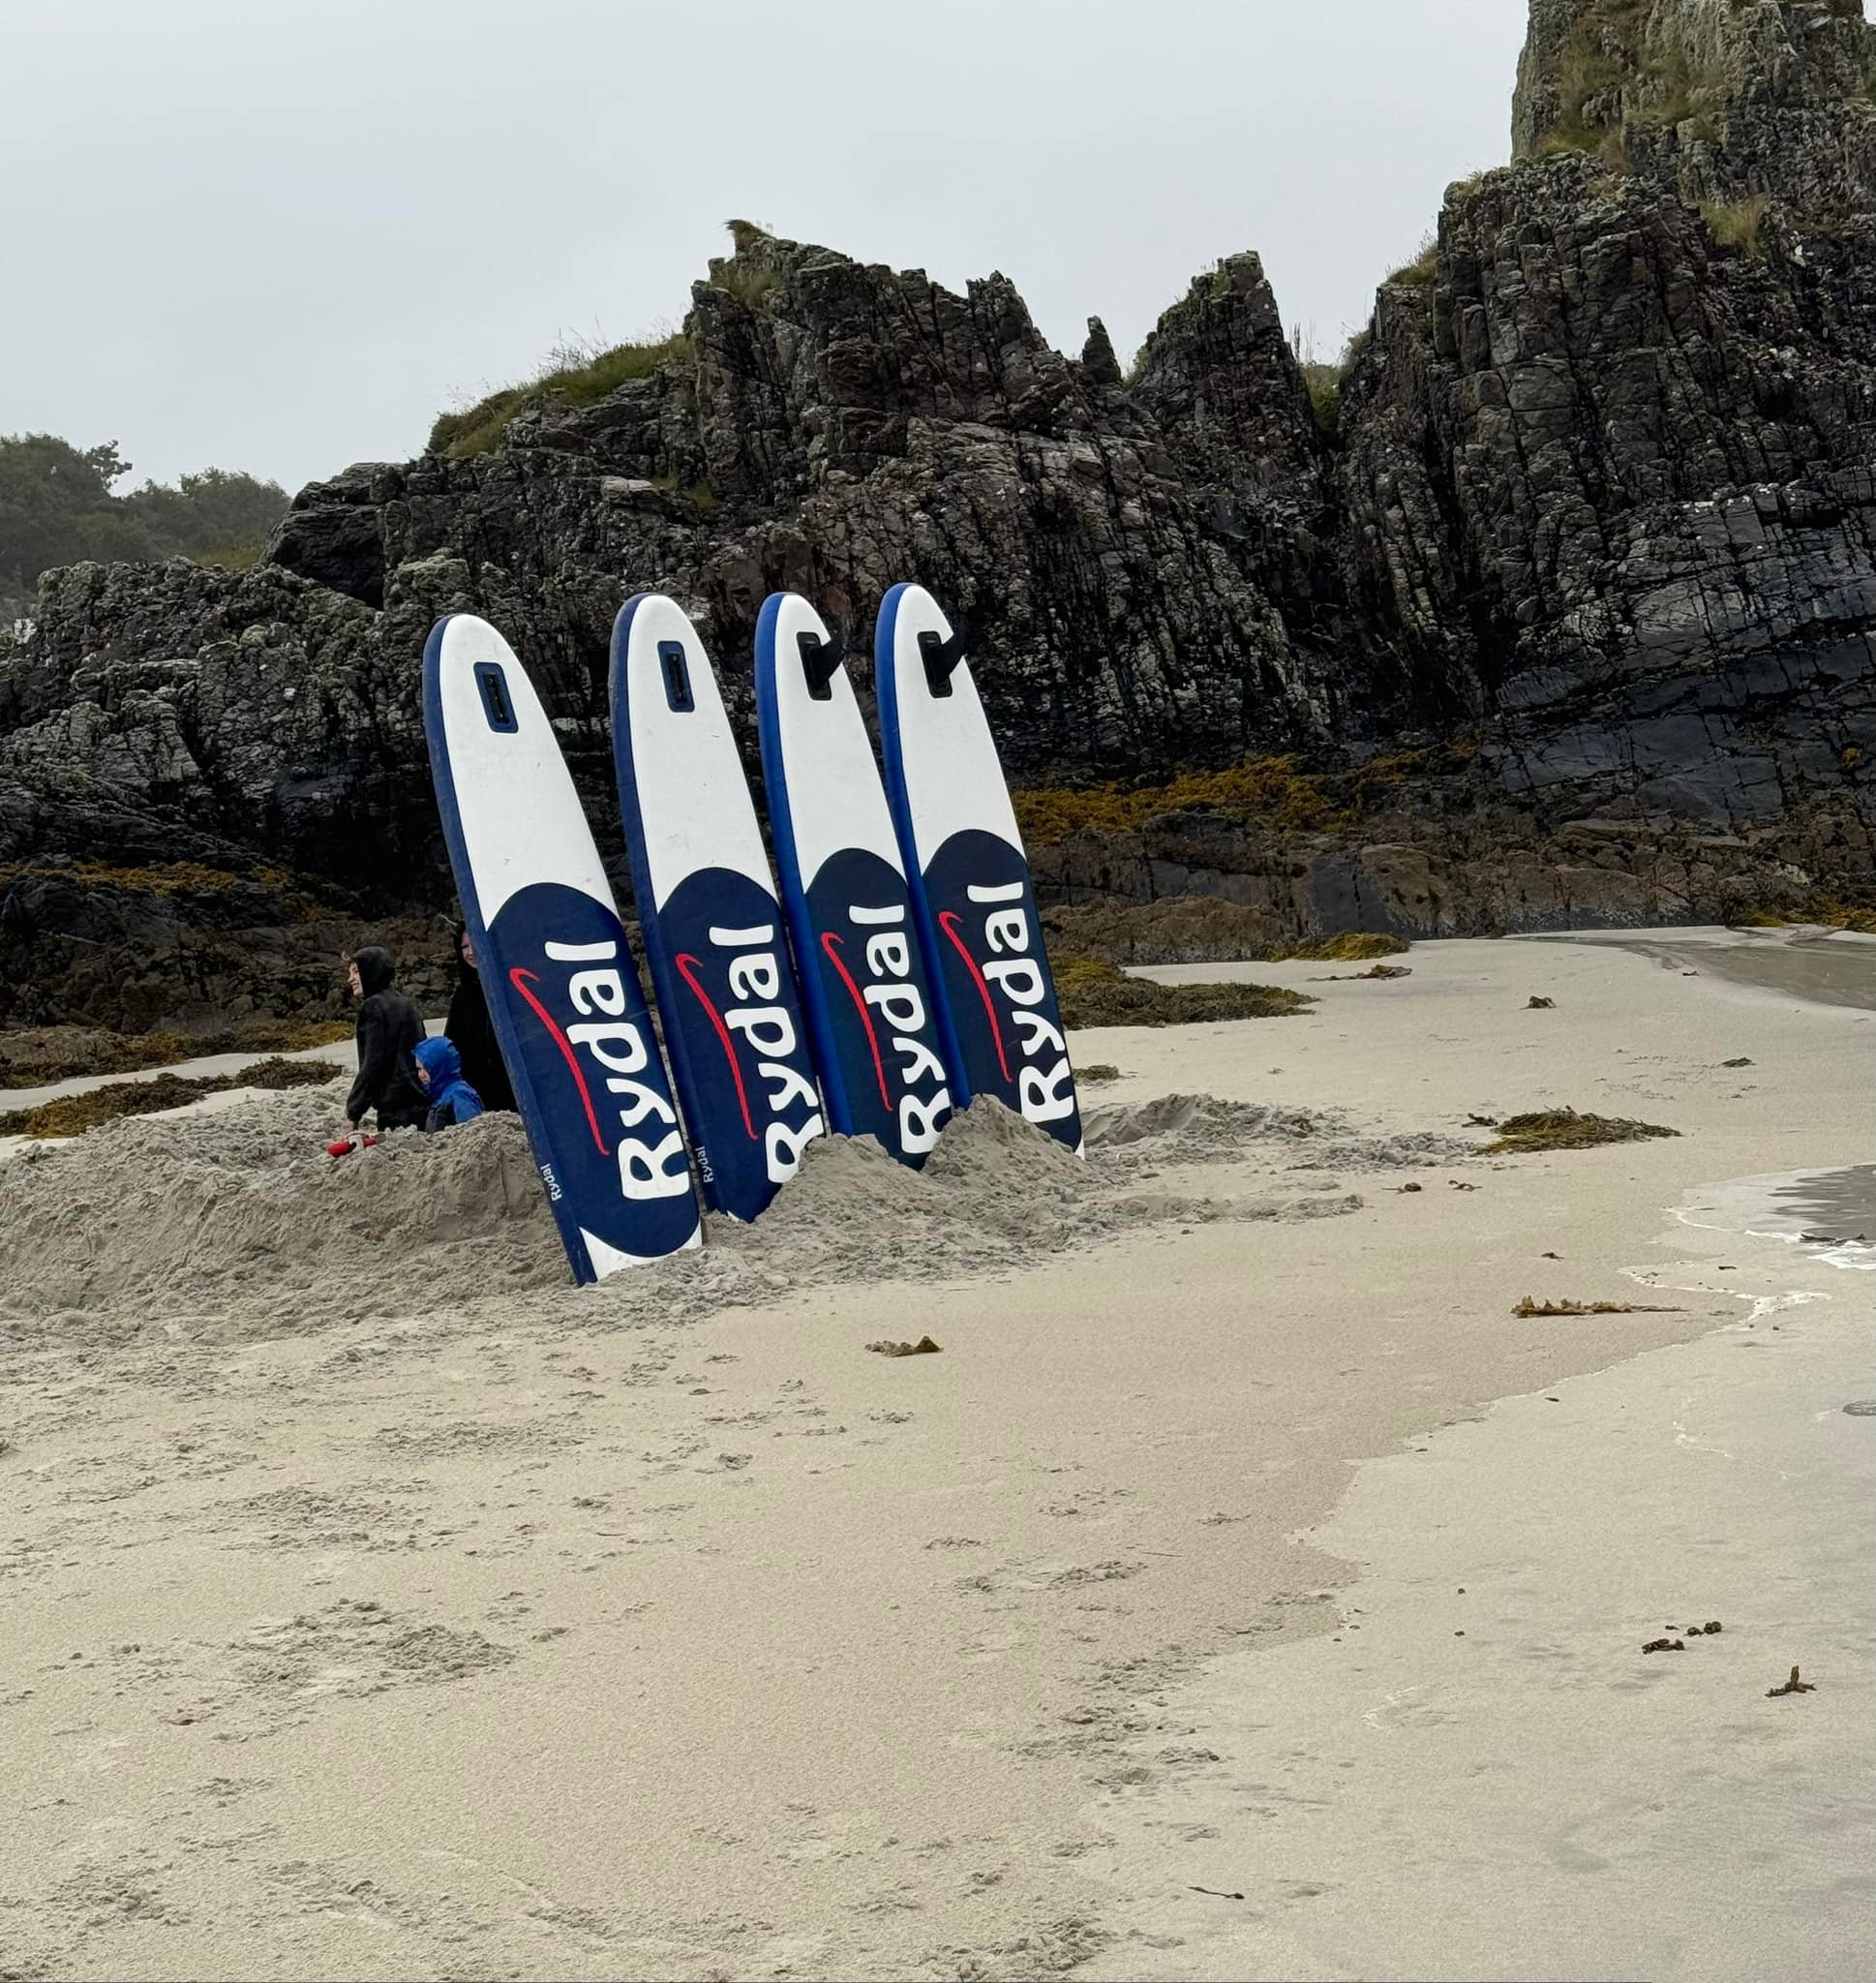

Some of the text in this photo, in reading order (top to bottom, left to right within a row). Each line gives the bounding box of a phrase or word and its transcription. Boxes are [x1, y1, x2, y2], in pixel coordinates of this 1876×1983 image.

[544, 941, 689, 1200] Rydal
[709, 925, 824, 1183] Rydal
[849, 904, 952, 1153] Rydal
[967, 881, 1074, 1123] Rydal
[540, 1163, 562, 1201] Rydal
[696, 1146, 714, 1182] Rydal
